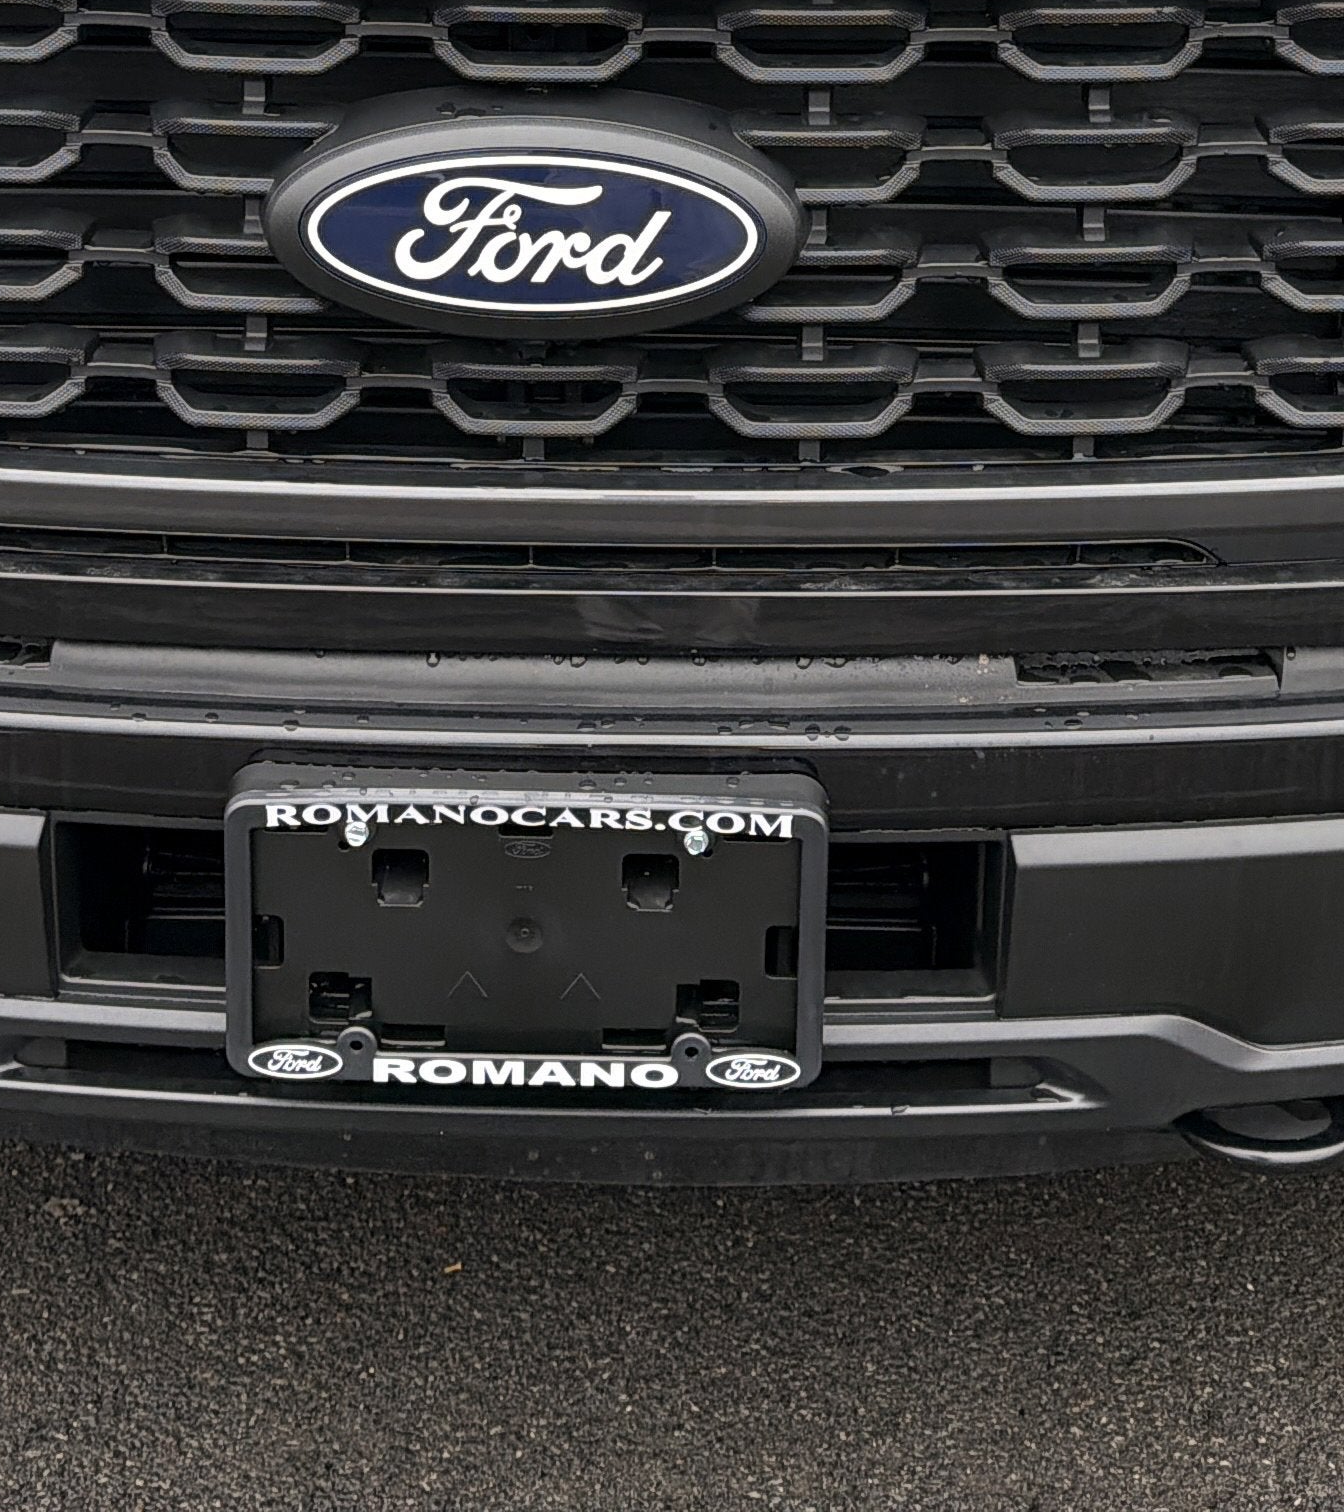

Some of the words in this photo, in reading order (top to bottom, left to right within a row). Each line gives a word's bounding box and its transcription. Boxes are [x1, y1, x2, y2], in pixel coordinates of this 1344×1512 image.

[394, 177, 672, 287] Ford
[265, 803, 794, 837] ROMANOCARS.COM
[267, 1050, 323, 1072] Ford
[372, 1058, 679, 1087] ROMANO
[724, 1058, 781, 1081] Ford
